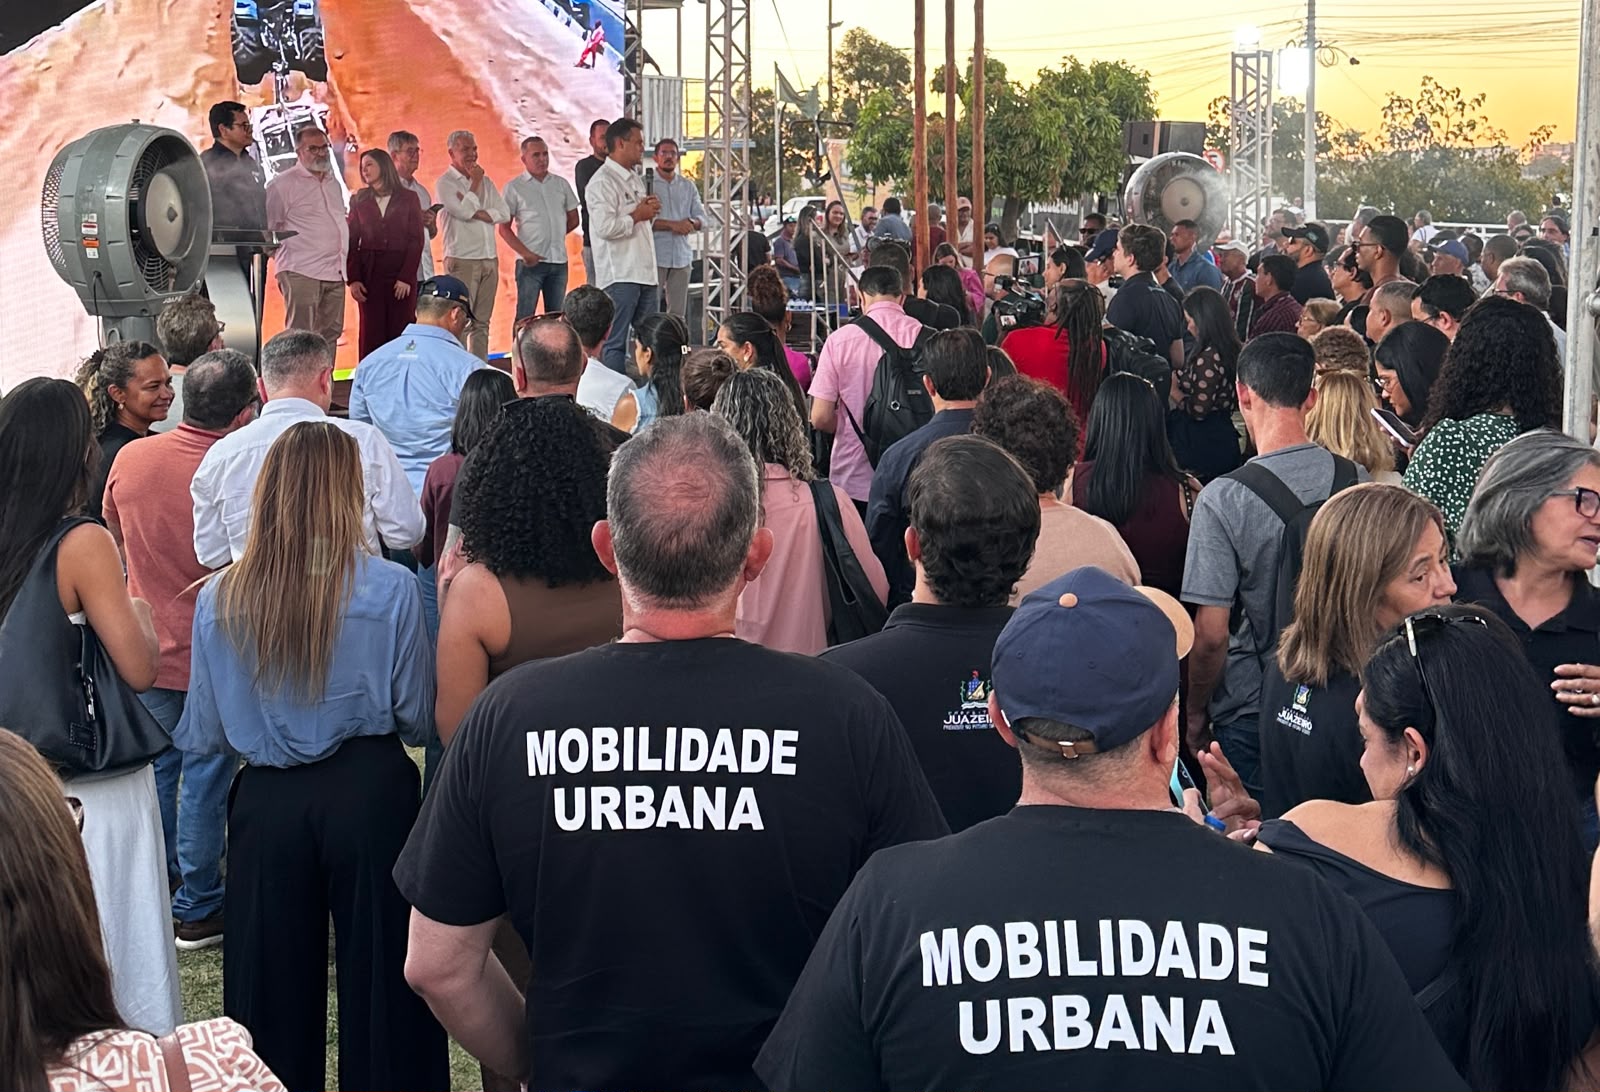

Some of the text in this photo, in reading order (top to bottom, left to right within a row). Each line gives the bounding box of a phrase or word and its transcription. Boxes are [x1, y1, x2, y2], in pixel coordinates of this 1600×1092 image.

[943, 714, 993, 725] JUAZEI
[1278, 710, 1312, 731] JUAZEIRO
[526, 726, 799, 777] MOBILIDADE
[553, 785, 765, 832] URBANA
[919, 919, 1269, 988] MOBILIDADE
[958, 994, 1236, 1056] URBANA
